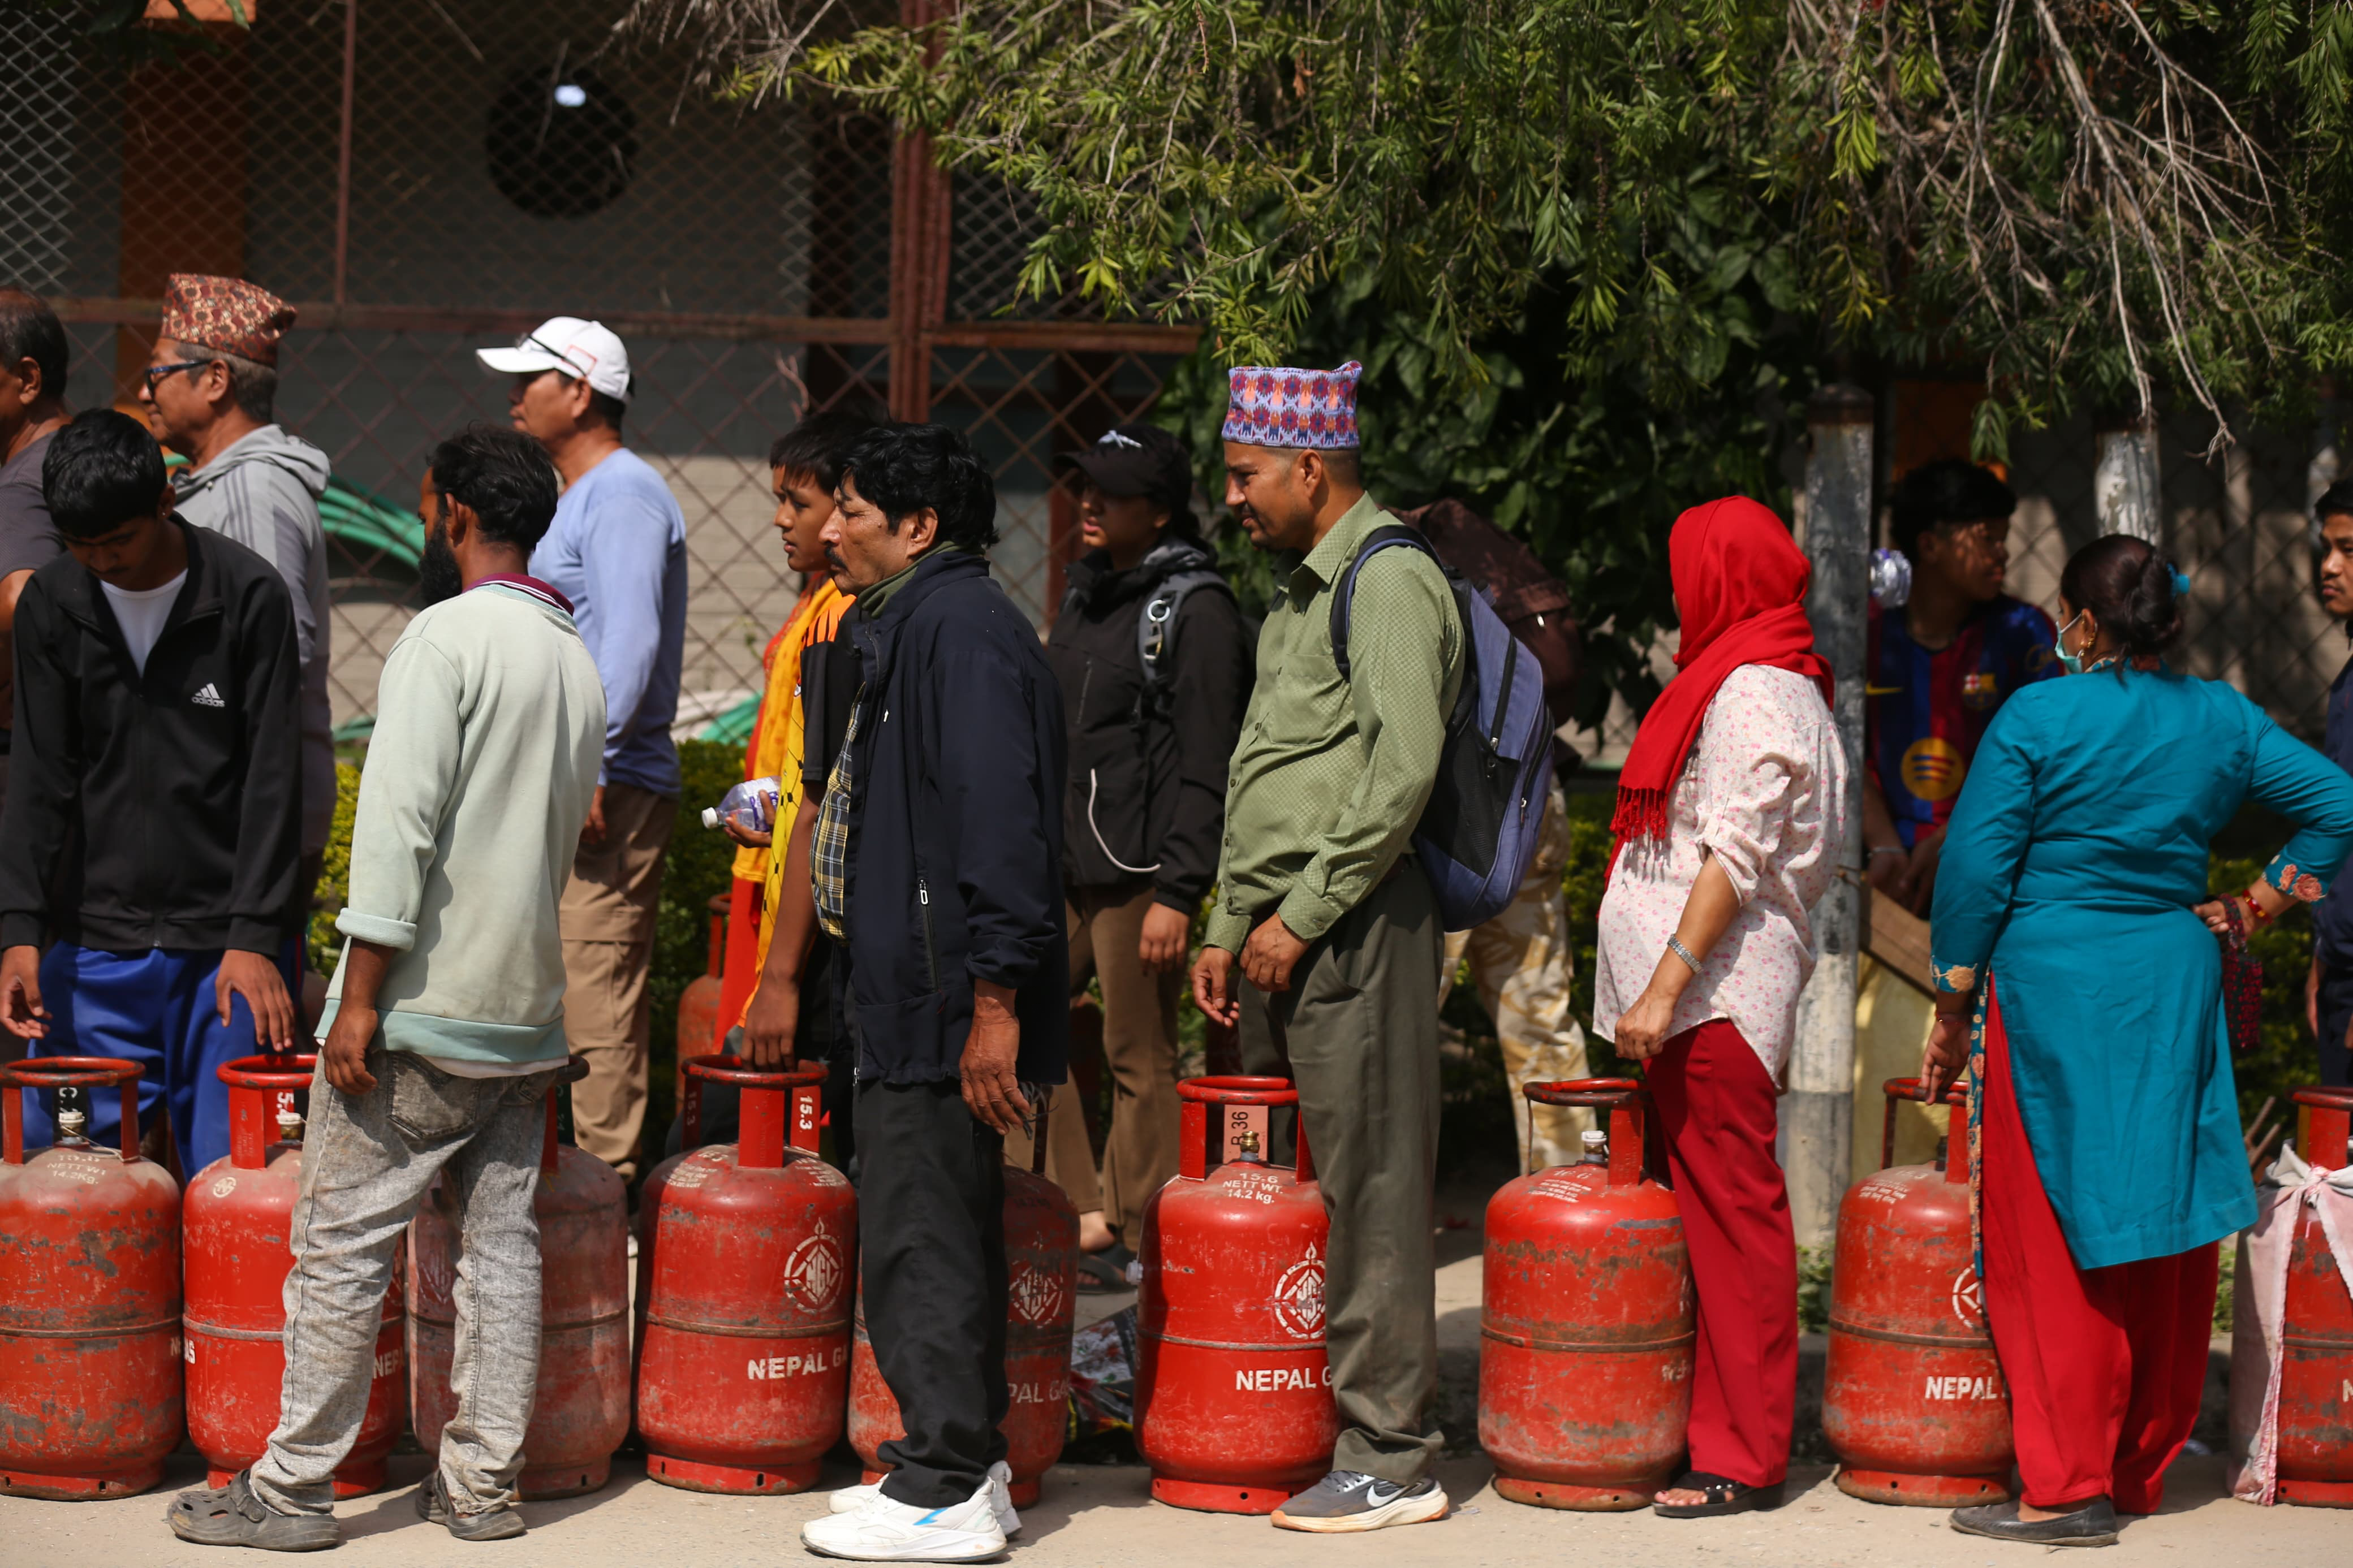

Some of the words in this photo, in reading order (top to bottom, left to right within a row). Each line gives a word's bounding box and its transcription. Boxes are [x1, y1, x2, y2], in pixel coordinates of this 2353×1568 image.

[192, 696, 225, 707] adidas
[799, 1095, 813, 1130] 15.3
[1231, 1111, 1249, 1130] 36
[48, 1163, 84, 1171] NETT
[1222, 1180, 1259, 1189] NETT
[1261, 1182, 1284, 1194] WT.
[1239, 1172, 1279, 1183] 15.6
[1227, 1189, 1253, 1199] 14.2
[748, 1352, 828, 1380] NEPAL
[1235, 1367, 1318, 1392] NEPAL
[1925, 1376, 1998, 1400] NEPAL
[1007, 1381, 1044, 1403] PAL
